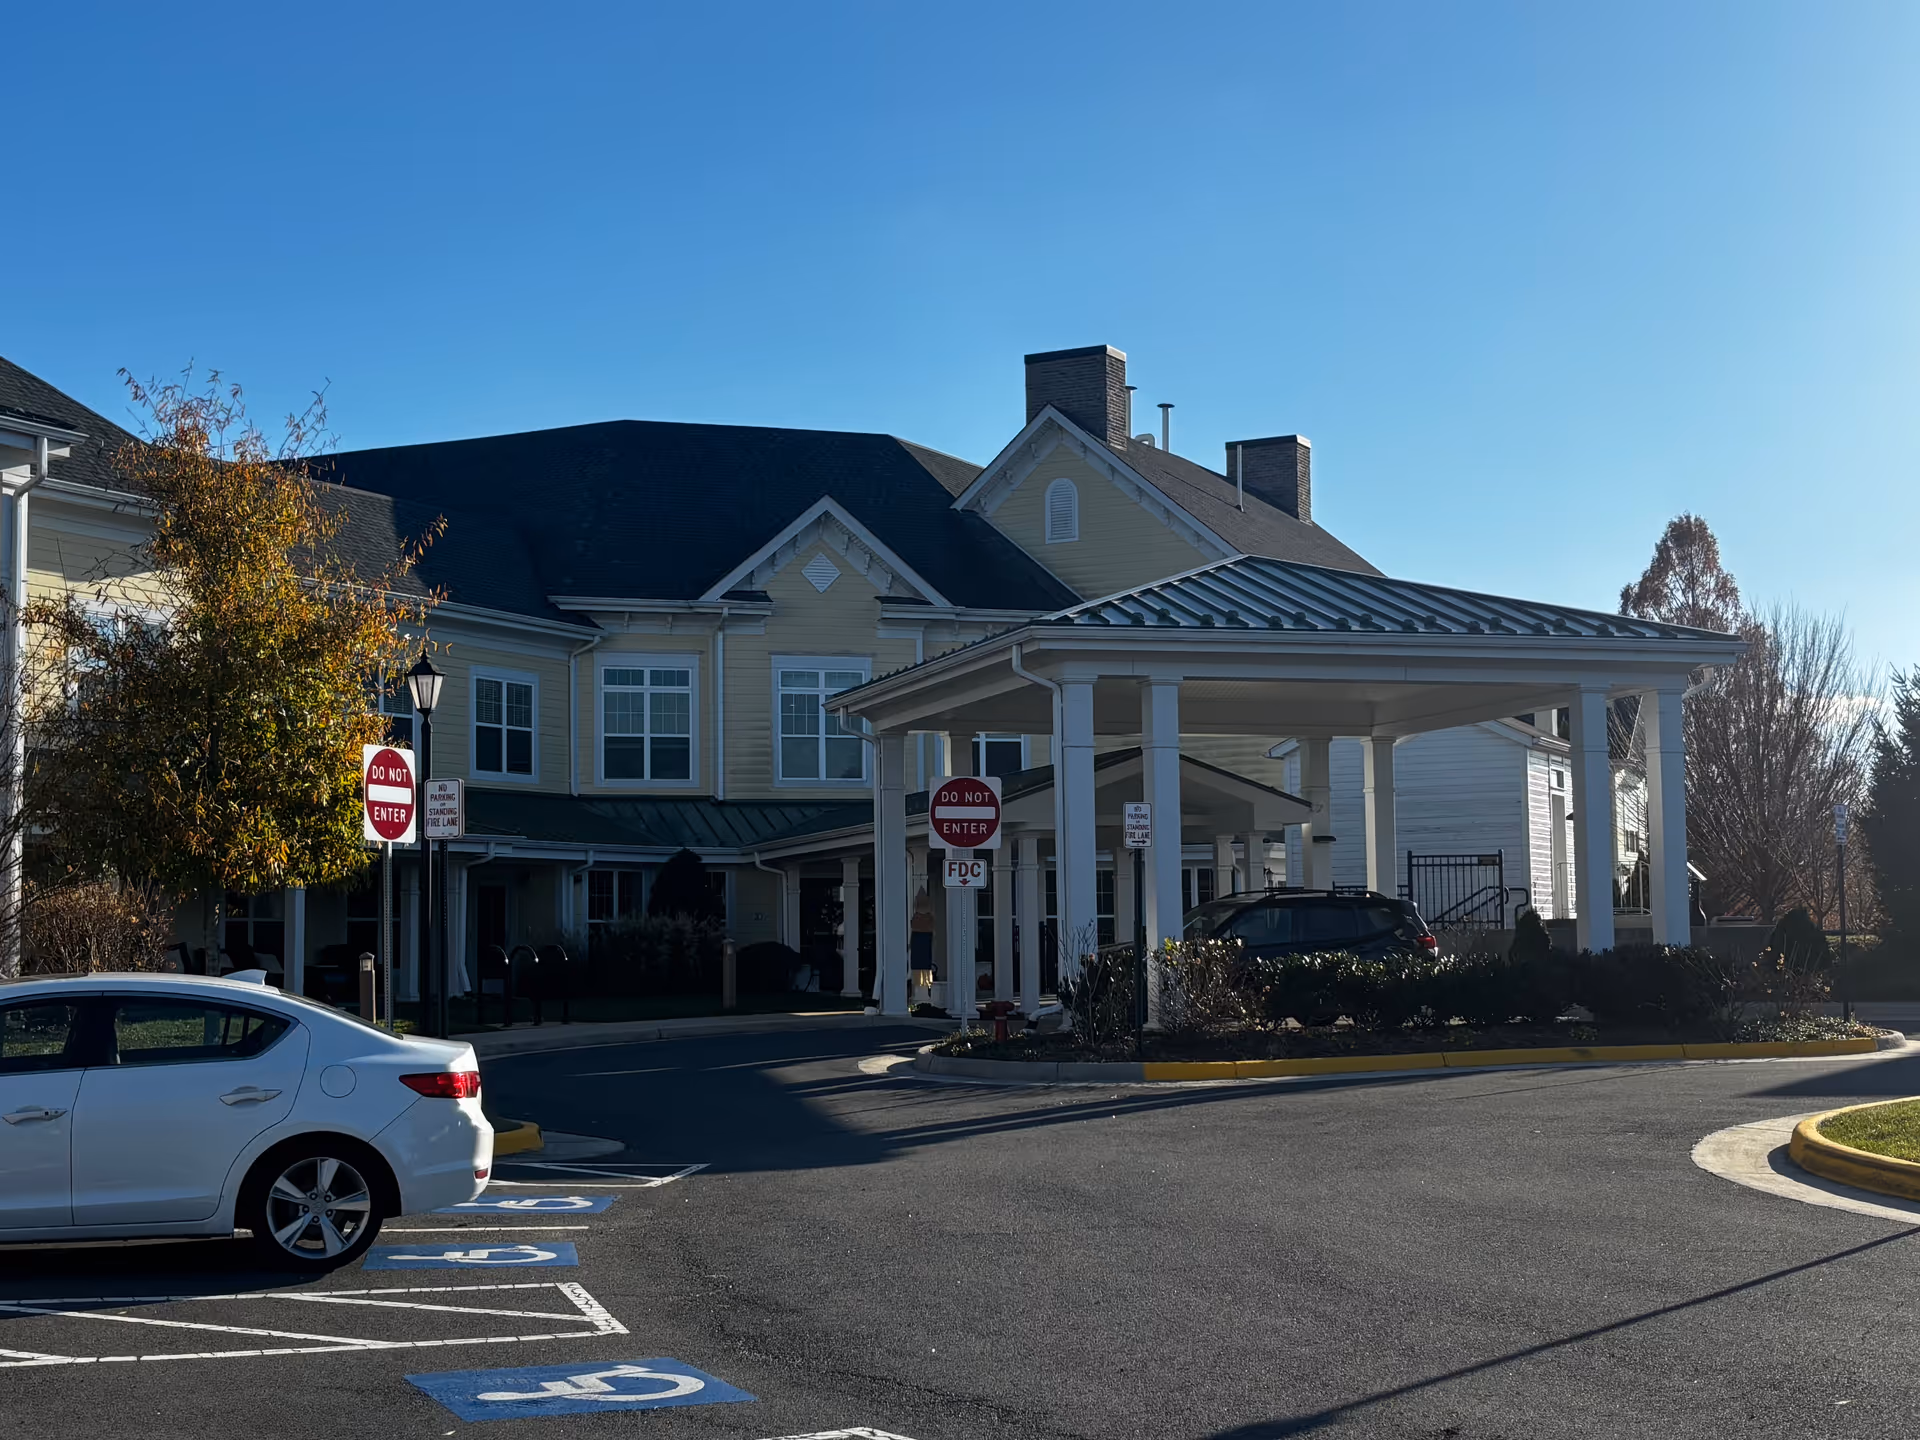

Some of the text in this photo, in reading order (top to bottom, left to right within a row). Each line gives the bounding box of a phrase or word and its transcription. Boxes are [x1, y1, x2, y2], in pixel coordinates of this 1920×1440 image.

[372, 765, 407, 782] DO NOT
[438, 784, 448, 792] NO
[430, 793, 456, 801] PARKING
[941, 791, 990, 803] DO NOT
[374, 807, 406, 823] ENTER
[428, 808, 457, 816] STANDING
[427, 817, 459, 827] FIRE LANE
[943, 822, 988, 834] ENTER
[948, 862, 981, 877] FDC
